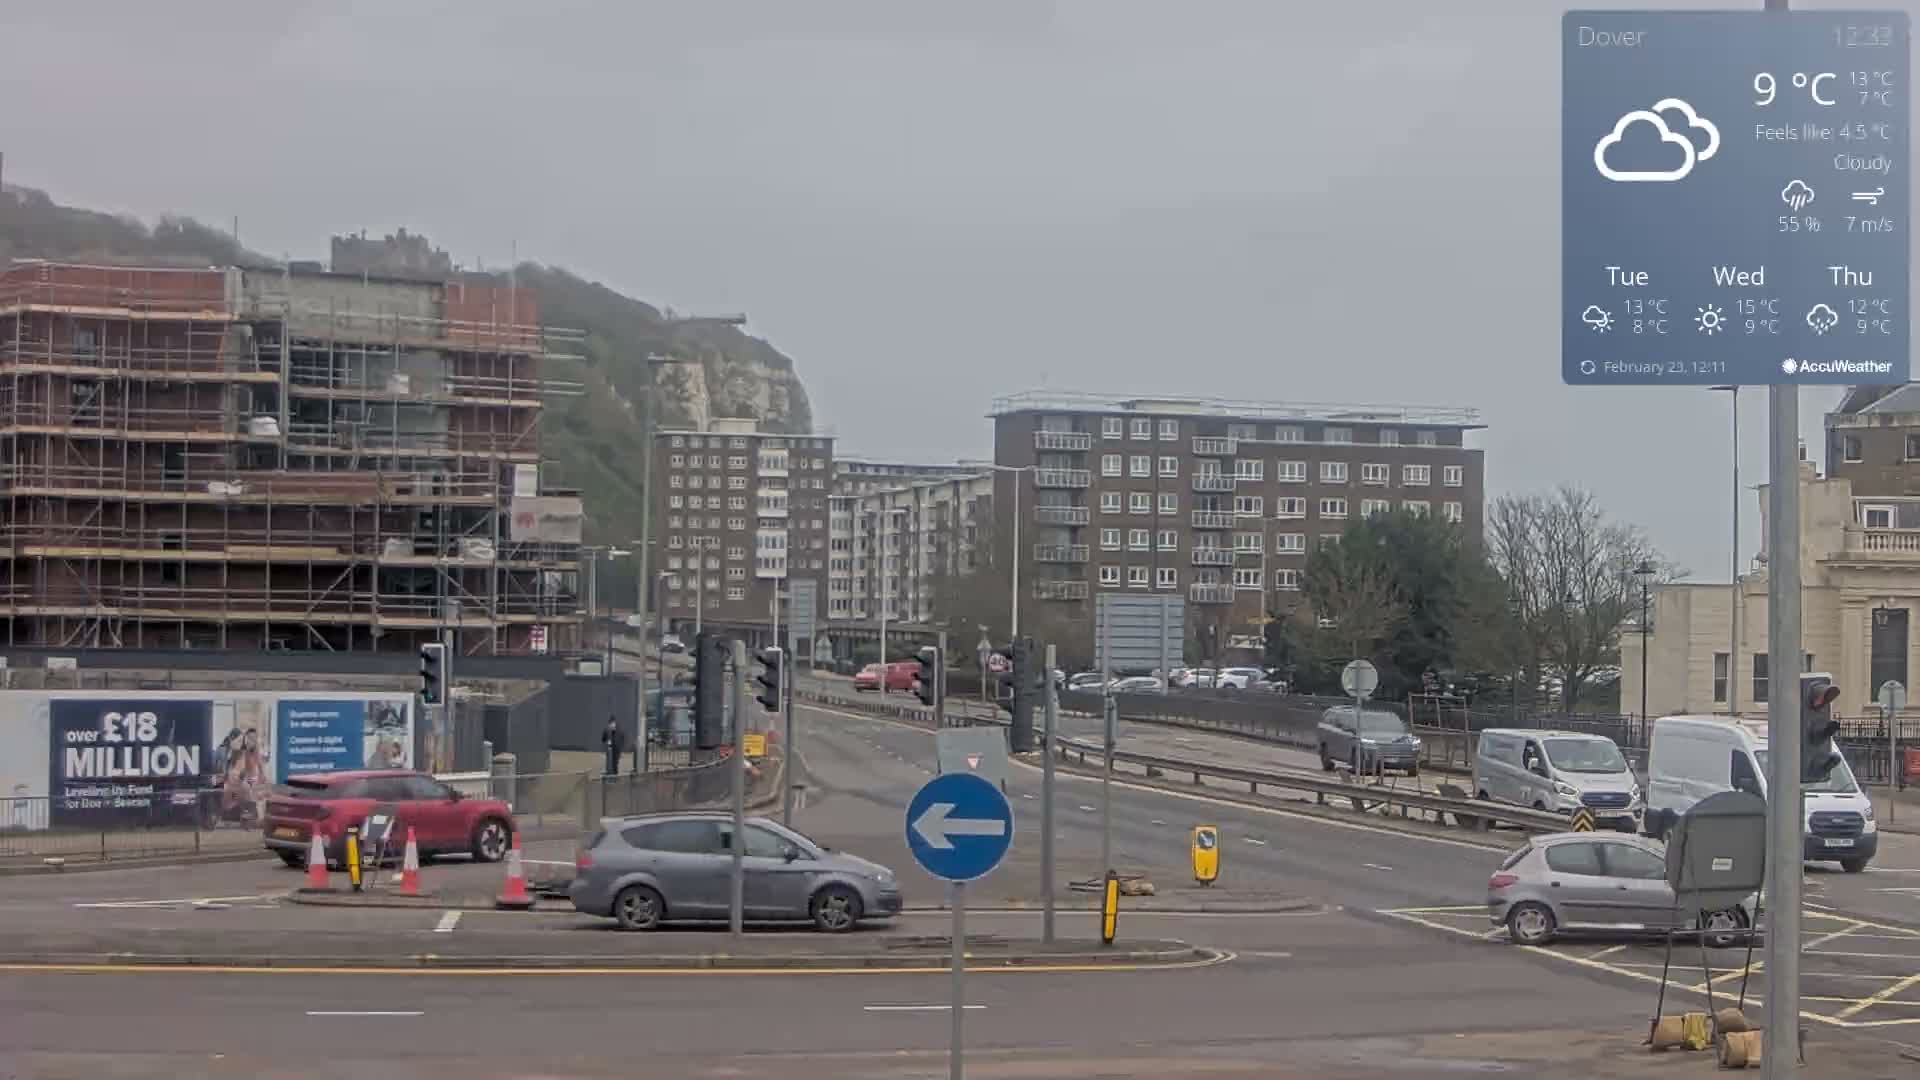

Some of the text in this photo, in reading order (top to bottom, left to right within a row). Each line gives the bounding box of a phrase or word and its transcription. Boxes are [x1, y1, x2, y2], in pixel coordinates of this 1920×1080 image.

[66, 711, 158, 742] over £18
[65, 745, 200, 777] MILLION
